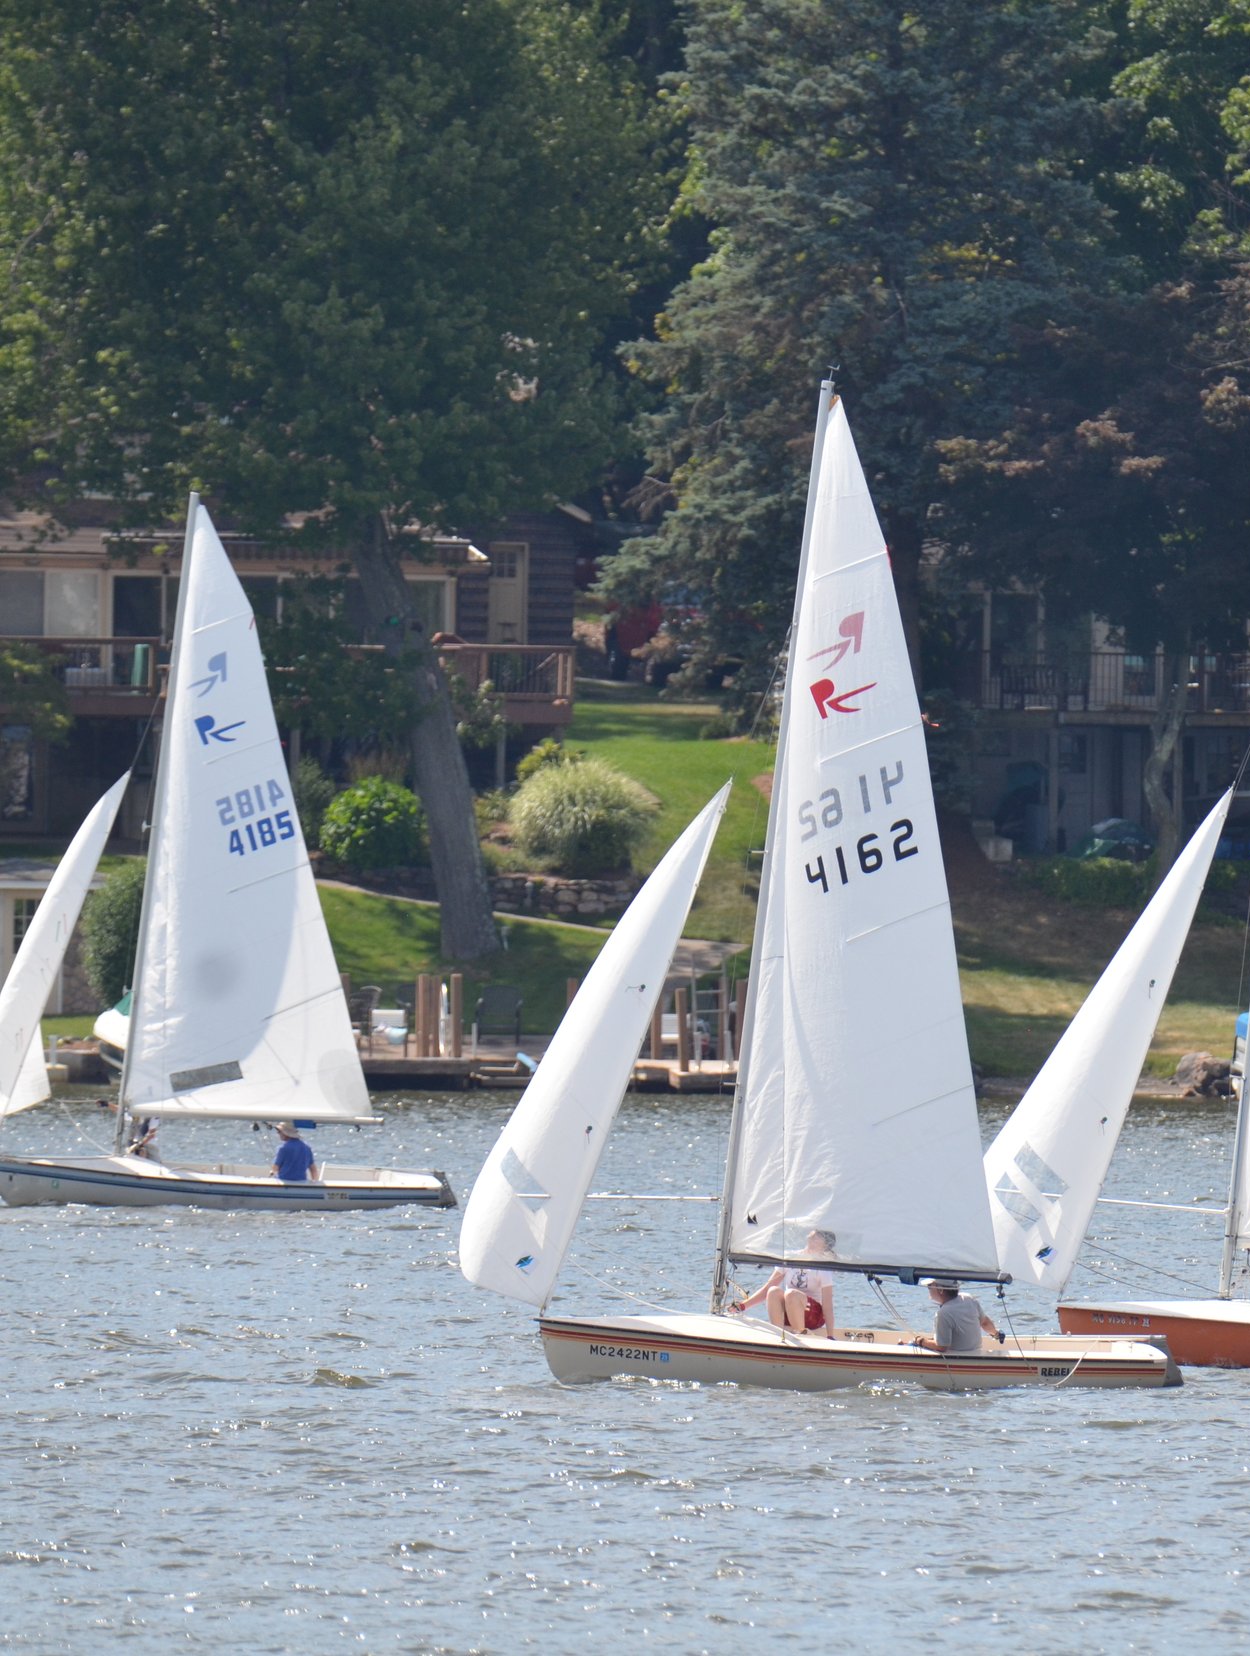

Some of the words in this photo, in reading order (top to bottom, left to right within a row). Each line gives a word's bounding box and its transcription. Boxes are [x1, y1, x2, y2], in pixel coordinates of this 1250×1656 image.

[228, 809, 296, 856] 4185
[804, 817, 920, 895] 4162
[589, 1344, 658, 1361] MC2422NT
